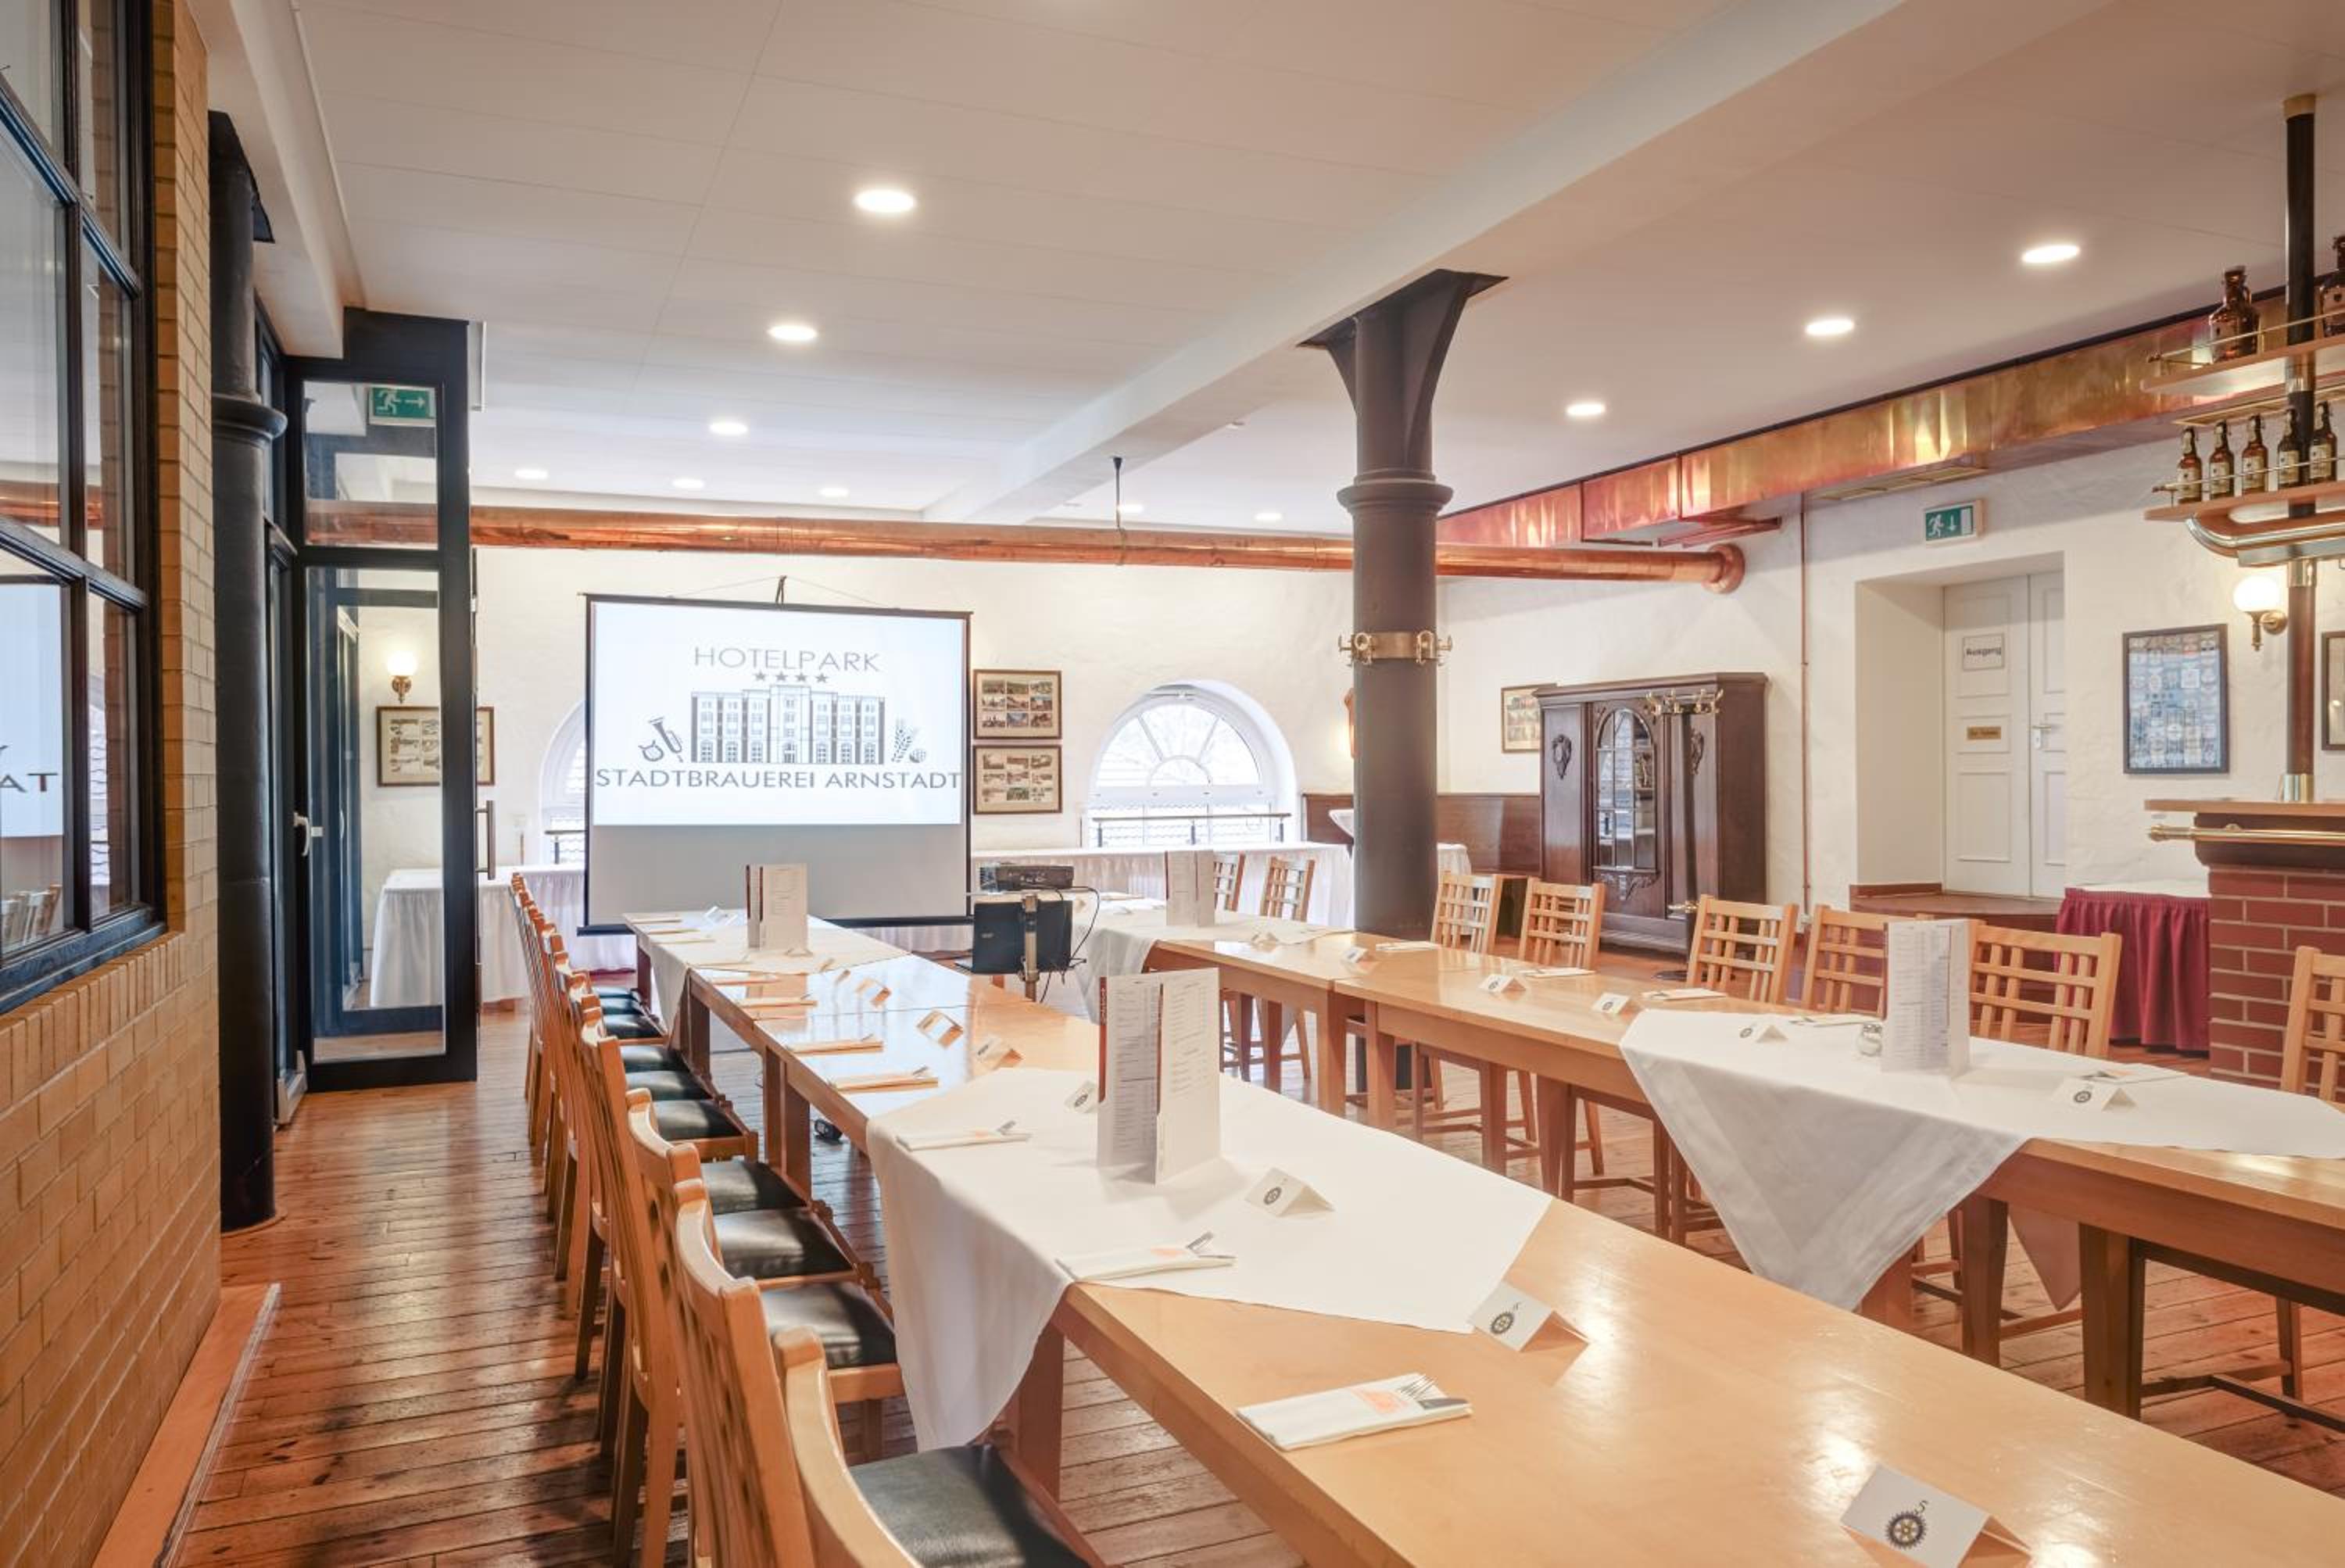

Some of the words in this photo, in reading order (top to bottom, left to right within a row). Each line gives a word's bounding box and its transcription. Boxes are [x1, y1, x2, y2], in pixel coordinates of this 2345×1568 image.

[694, 646, 880, 672] HOTELPARK
[596, 768, 815, 788] STADTBRAUEREI
[825, 771, 961, 789] ARNSTADT
